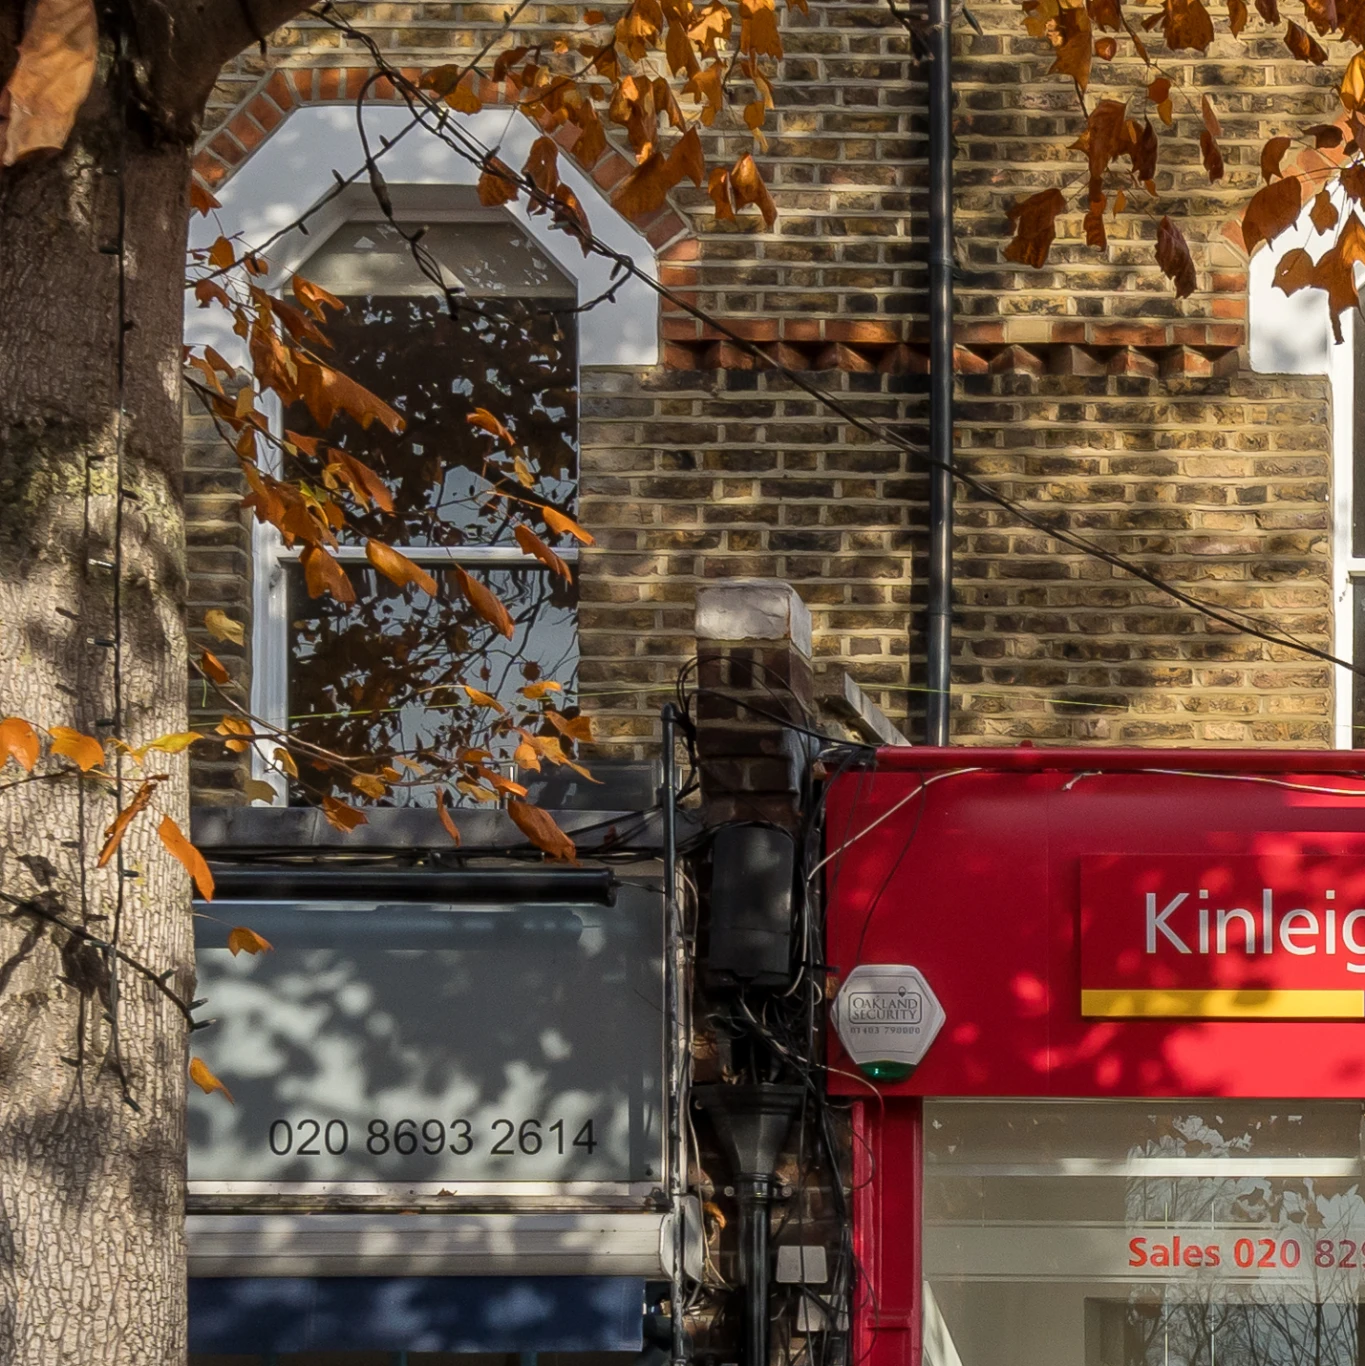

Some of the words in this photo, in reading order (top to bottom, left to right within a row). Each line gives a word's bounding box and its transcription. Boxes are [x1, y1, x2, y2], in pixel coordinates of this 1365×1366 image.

[852, 997, 919, 1010] OAKLAND
[852, 1009, 918, 1020] SECURITY
[268, 1118, 350, 1157] 020
[365, 1118, 474, 1157] 8693
[490, 1118, 598, 1156] 2614
[1128, 1236, 1220, 1269] Sales
[1233, 1238, 1302, 1269] 020
